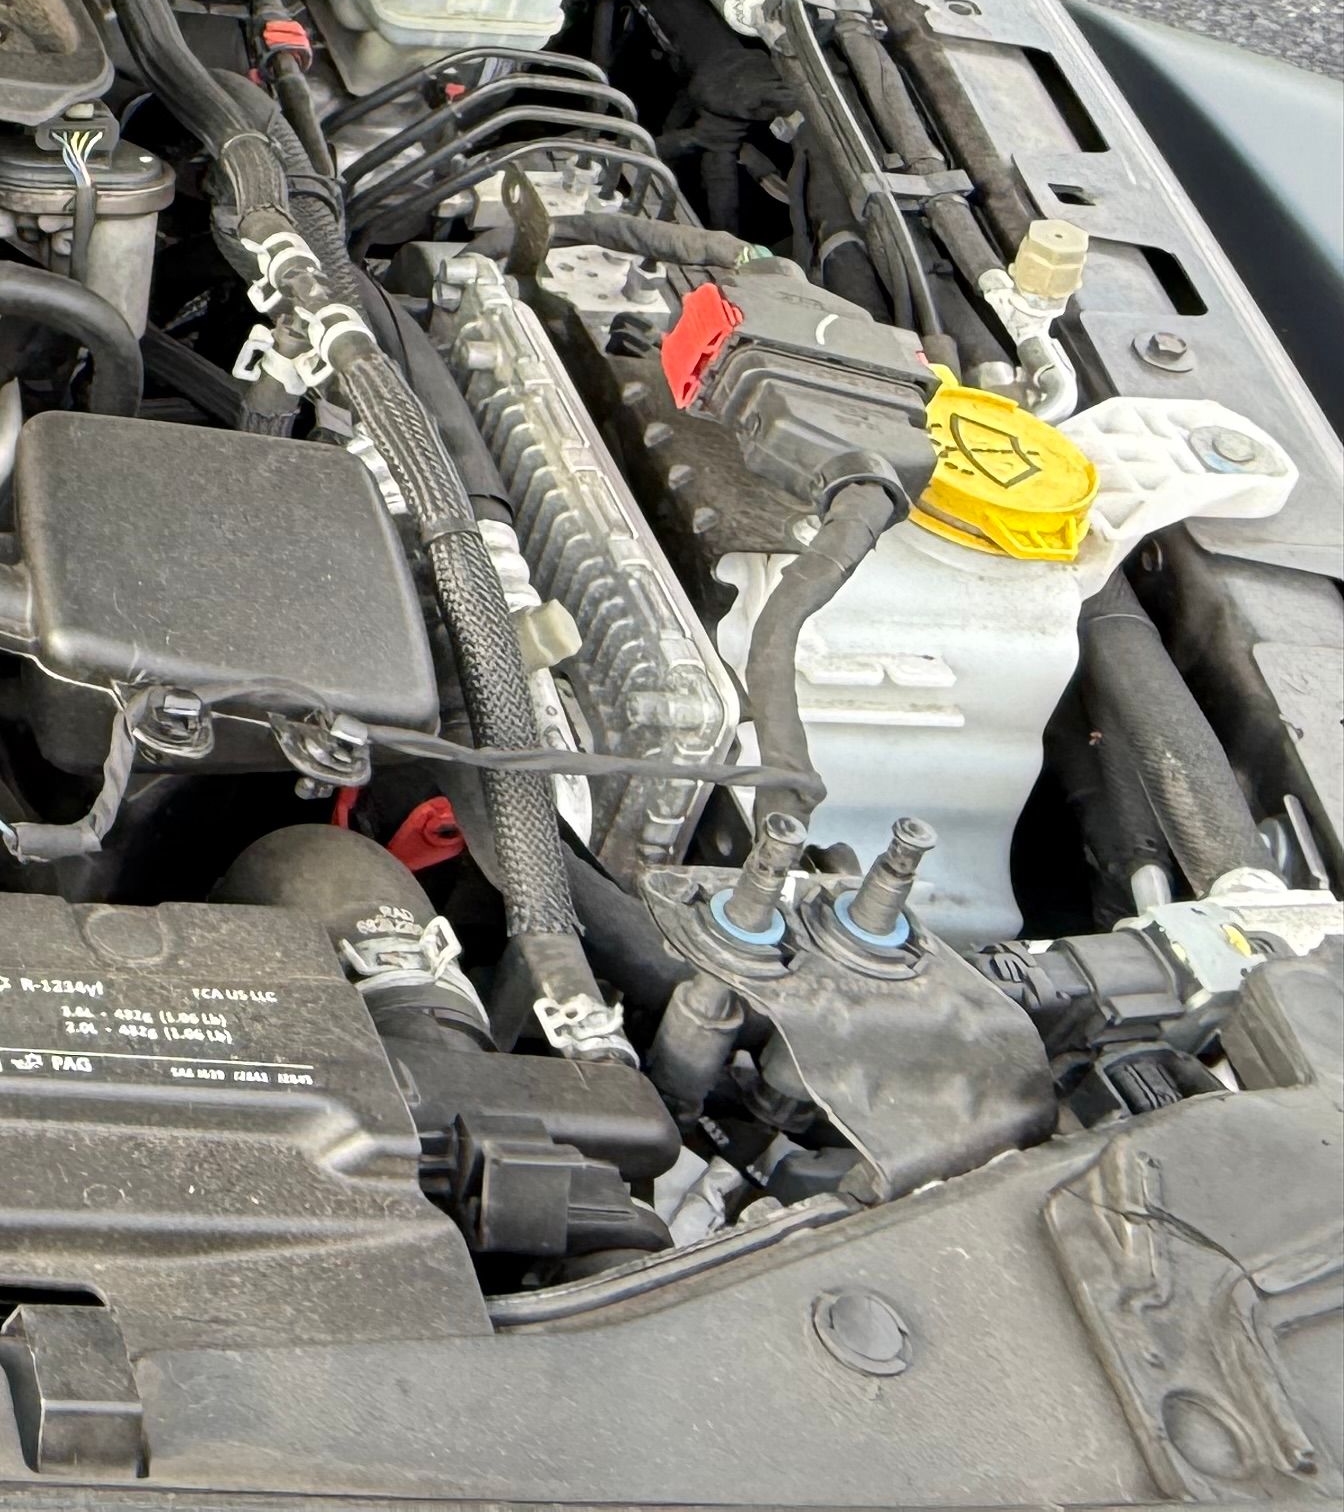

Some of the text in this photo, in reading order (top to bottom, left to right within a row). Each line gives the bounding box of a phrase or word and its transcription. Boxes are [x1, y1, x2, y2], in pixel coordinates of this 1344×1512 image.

[19, 977, 104, 998] R-1234yf
[191, 988, 278, 1004] FCA US LLC
[51, 1055, 93, 1073] PAG
